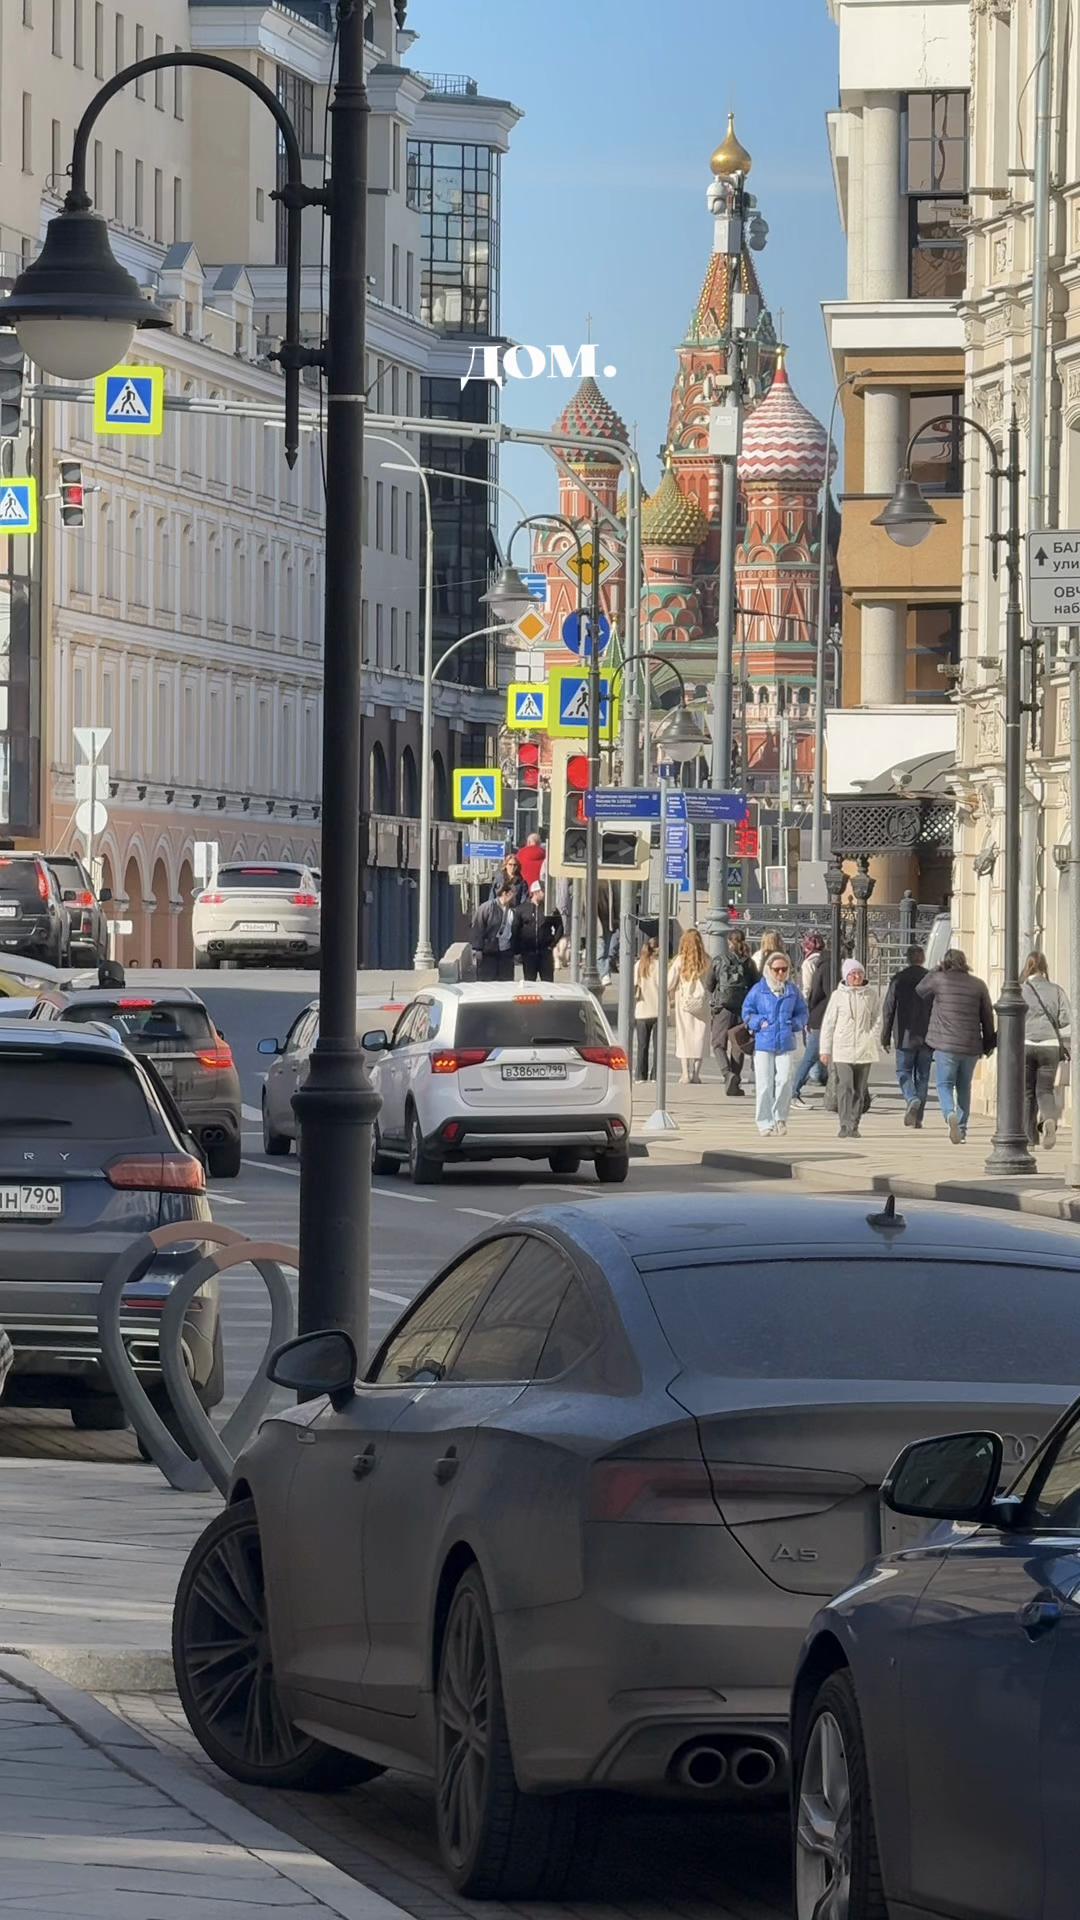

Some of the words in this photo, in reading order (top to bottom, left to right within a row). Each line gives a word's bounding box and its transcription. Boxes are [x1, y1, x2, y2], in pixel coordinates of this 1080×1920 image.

[1053, 560, 1079, 572] ули
[22, 1187, 56, 1204] 790
[770, 1544, 818, 1562] A5
